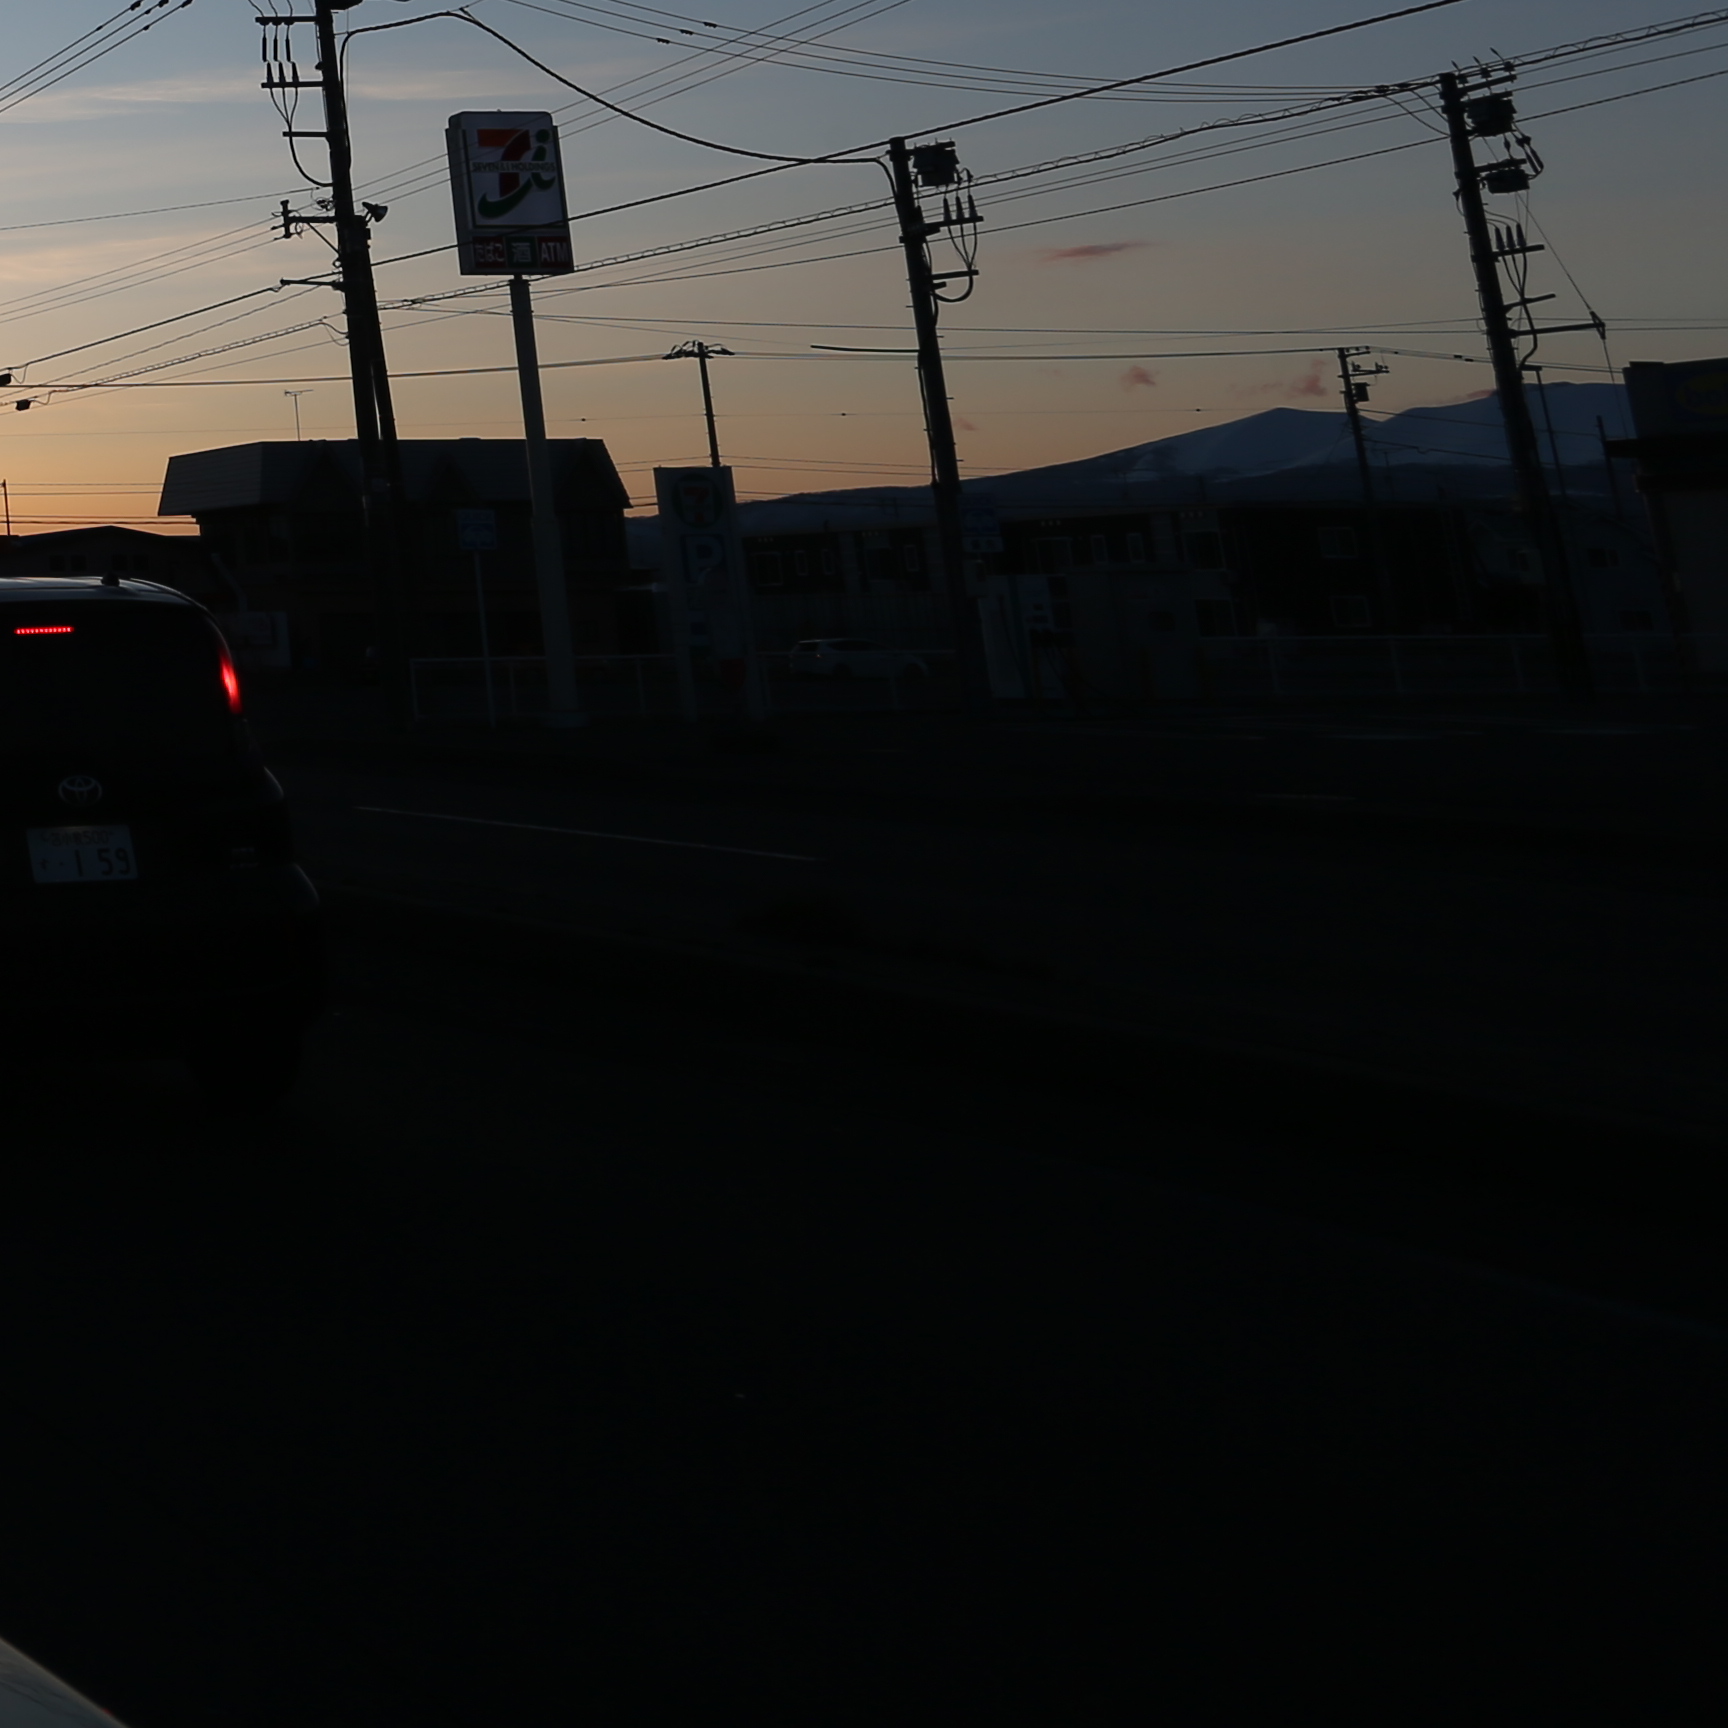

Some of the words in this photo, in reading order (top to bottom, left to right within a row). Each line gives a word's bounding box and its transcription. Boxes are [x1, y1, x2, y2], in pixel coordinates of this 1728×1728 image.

[511, 161, 556, 173] HOLDINGS
[475, 242, 505, 263] たばこ
[512, 242, 532, 263] 酒
[541, 242, 569, 263] ATM
[687, 536, 726, 584] P
